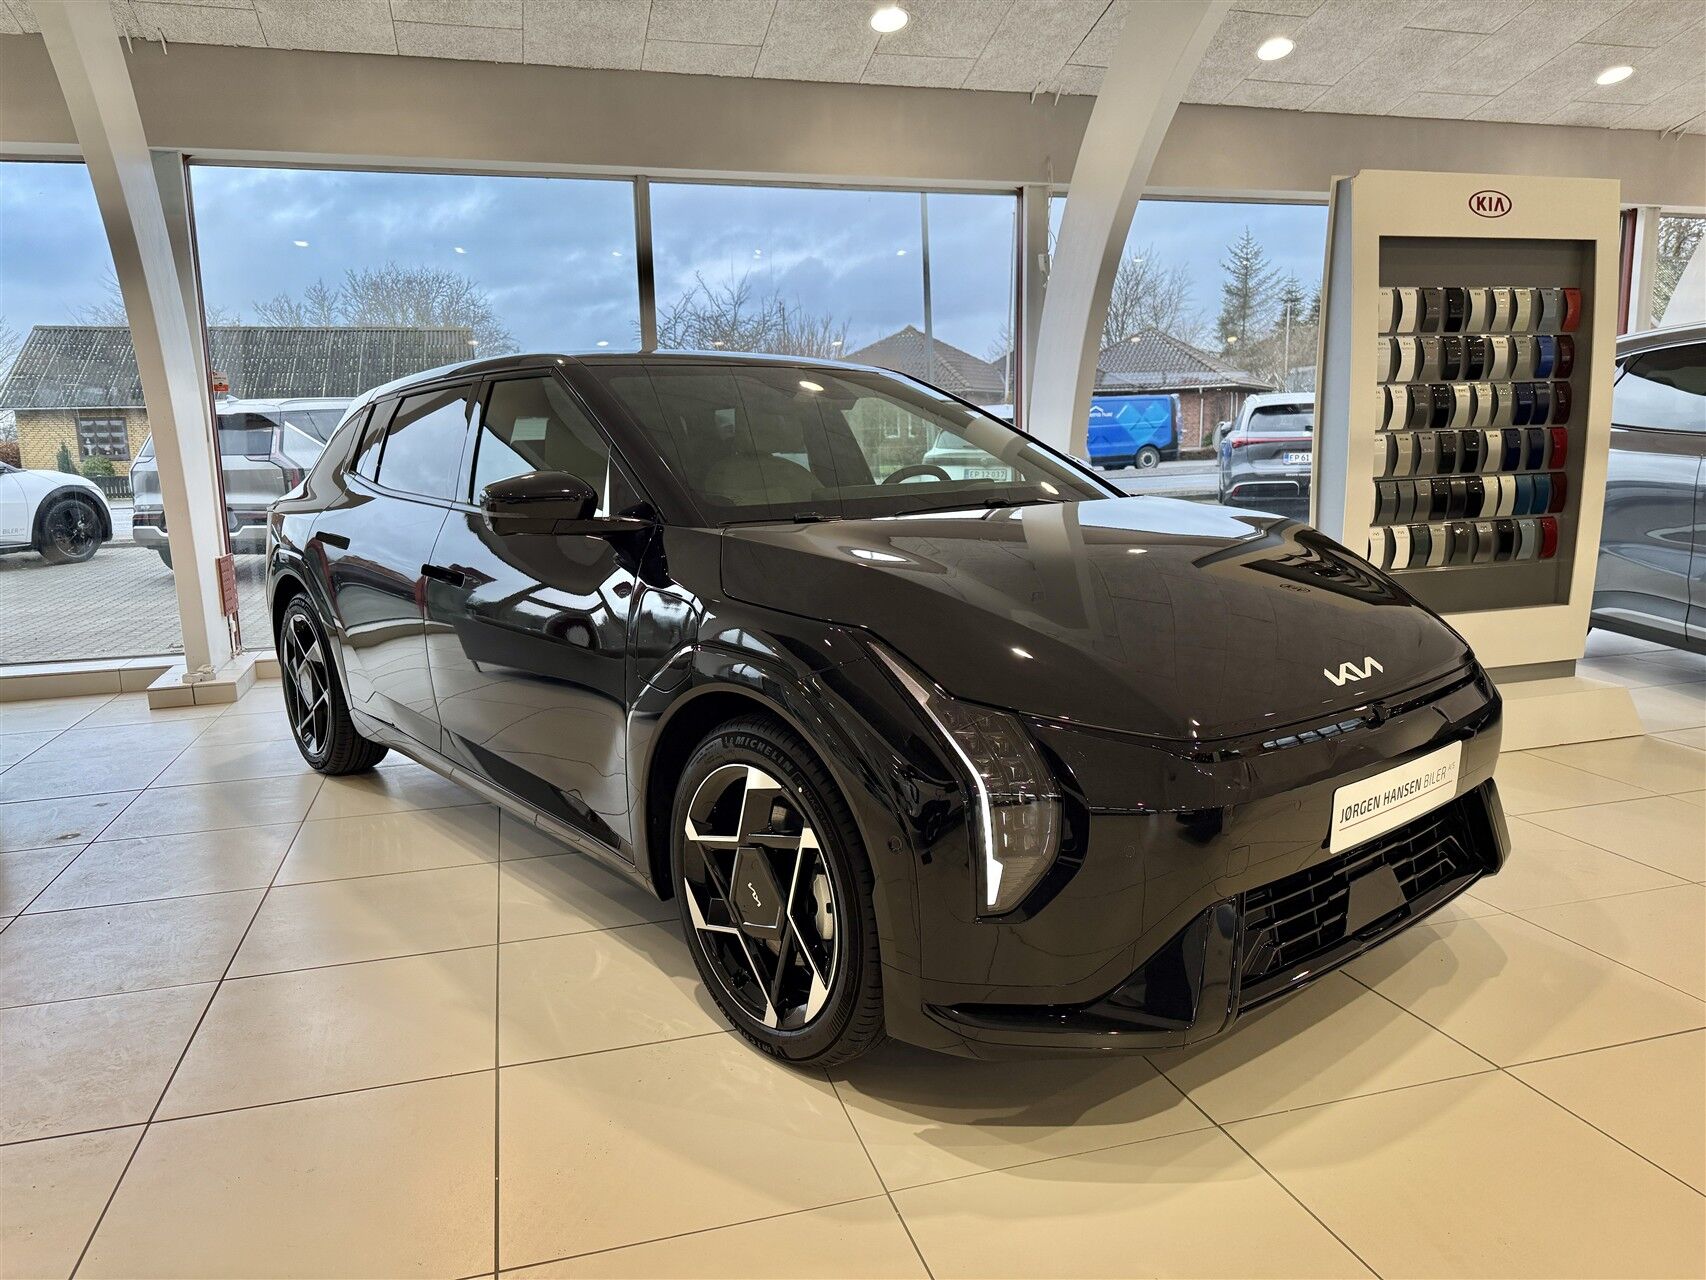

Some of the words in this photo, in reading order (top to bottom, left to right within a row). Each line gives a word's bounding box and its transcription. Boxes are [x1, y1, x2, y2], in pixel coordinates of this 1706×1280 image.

[1476, 196, 1505, 212] KIA
[1289, 454, 1299, 462] EP
[1300, 454, 1309, 462] 61
[969, 470, 980, 479] EP
[735, 735, 794, 773] MICHELIN
[1340, 794, 1381, 823] JØRGEN
[1383, 777, 1422, 806] HANSEN
[1424, 766, 1447, 788] BILER
